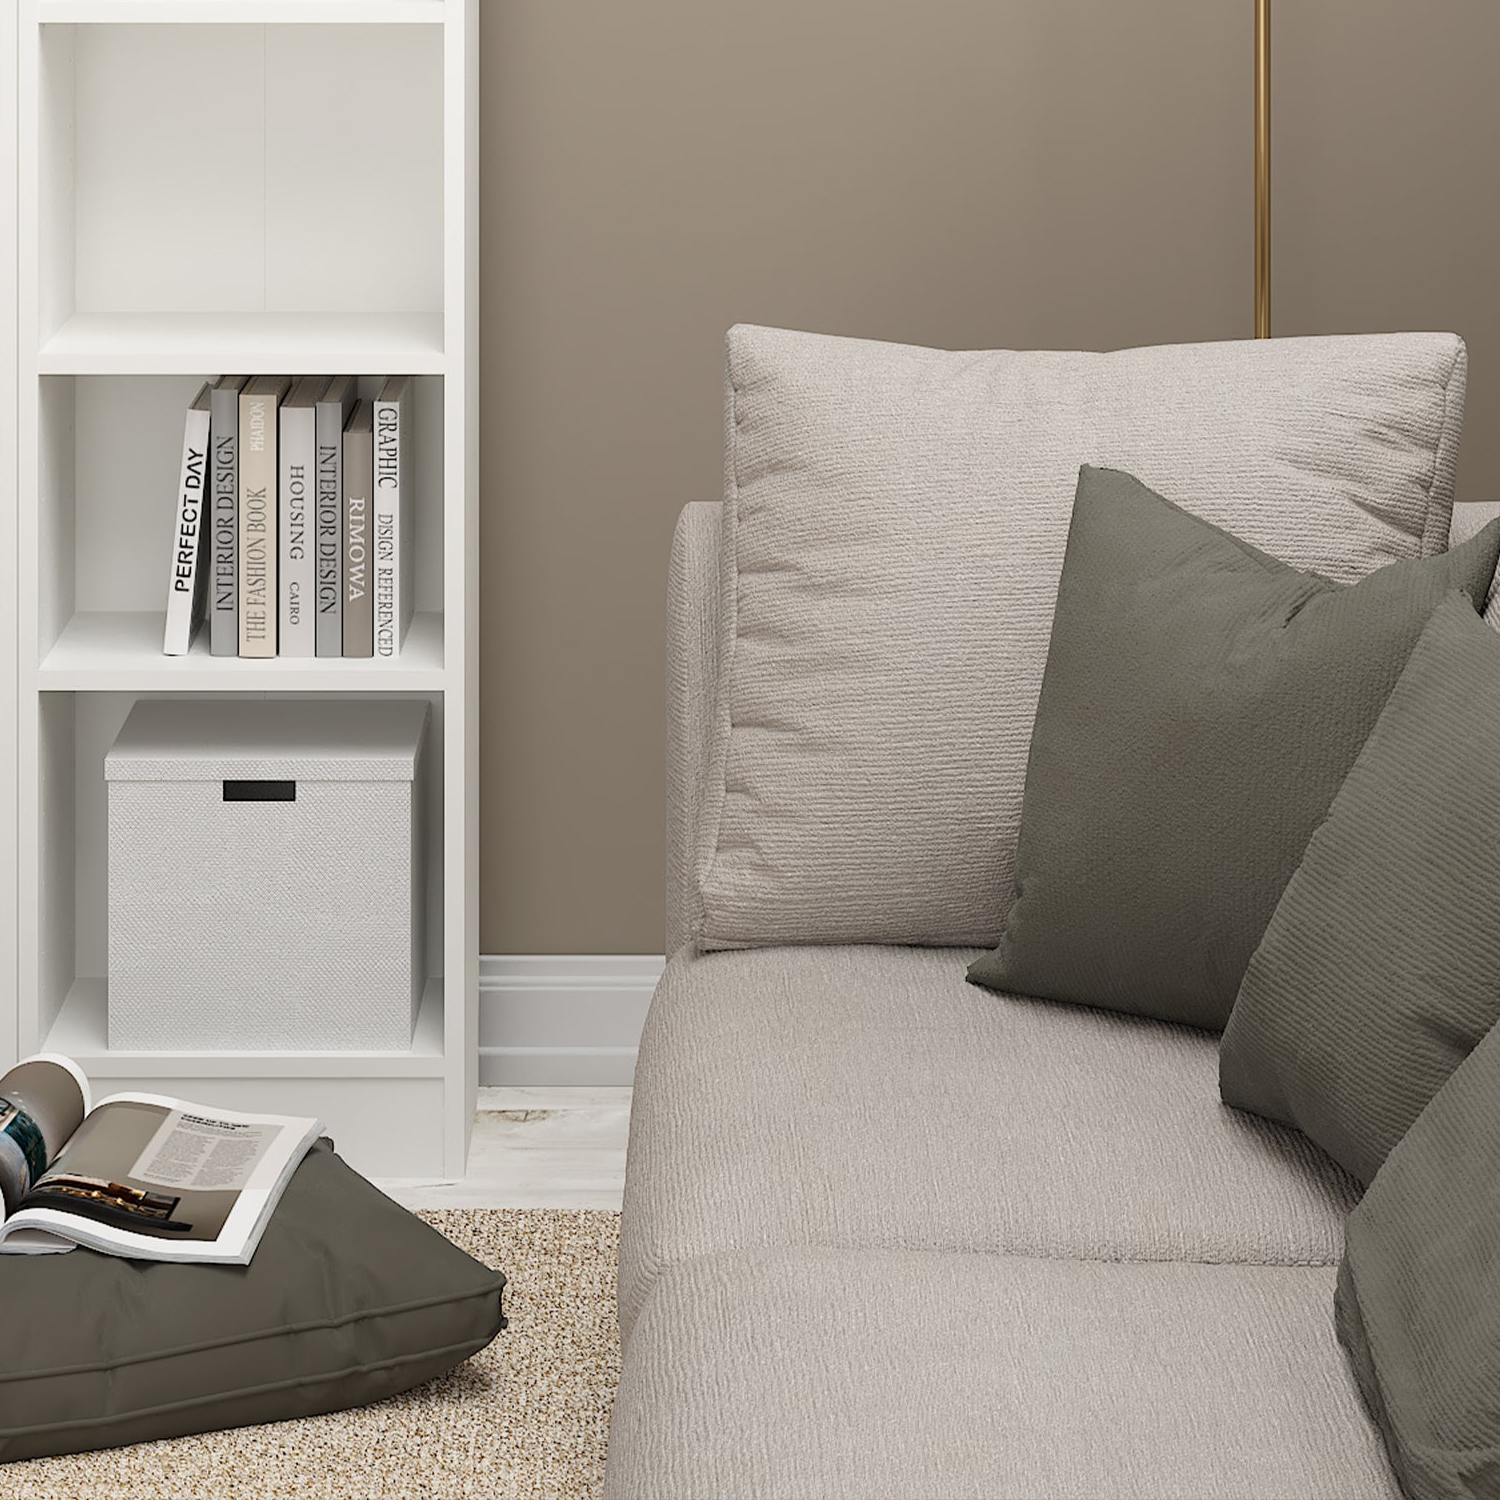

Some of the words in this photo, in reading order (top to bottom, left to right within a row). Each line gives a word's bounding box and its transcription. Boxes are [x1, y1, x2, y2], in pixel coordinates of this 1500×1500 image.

[250, 402, 265, 452] PHAIDON
[378, 408, 397, 488] GRAPHIC
[185, 448, 204, 488] DAY
[216, 436, 234, 510] DESIGN
[320, 446, 336, 537] INTERIOR
[175, 495, 200, 592] PERFECT
[246, 488, 266, 533] BOOK
[290, 465, 305, 560] HOUSING
[378, 514, 393, 561] DISIGN
[216, 517, 234, 611] INTERIOR
[246, 537, 266, 607] FASHION
[320, 543, 336, 614] DESIGN
[349, 497, 365, 602] RIMOWA
[246, 611, 266, 642] THE
[289, 582, 300, 625] CAIRO
[378, 567, 393, 657] REFERENCED
